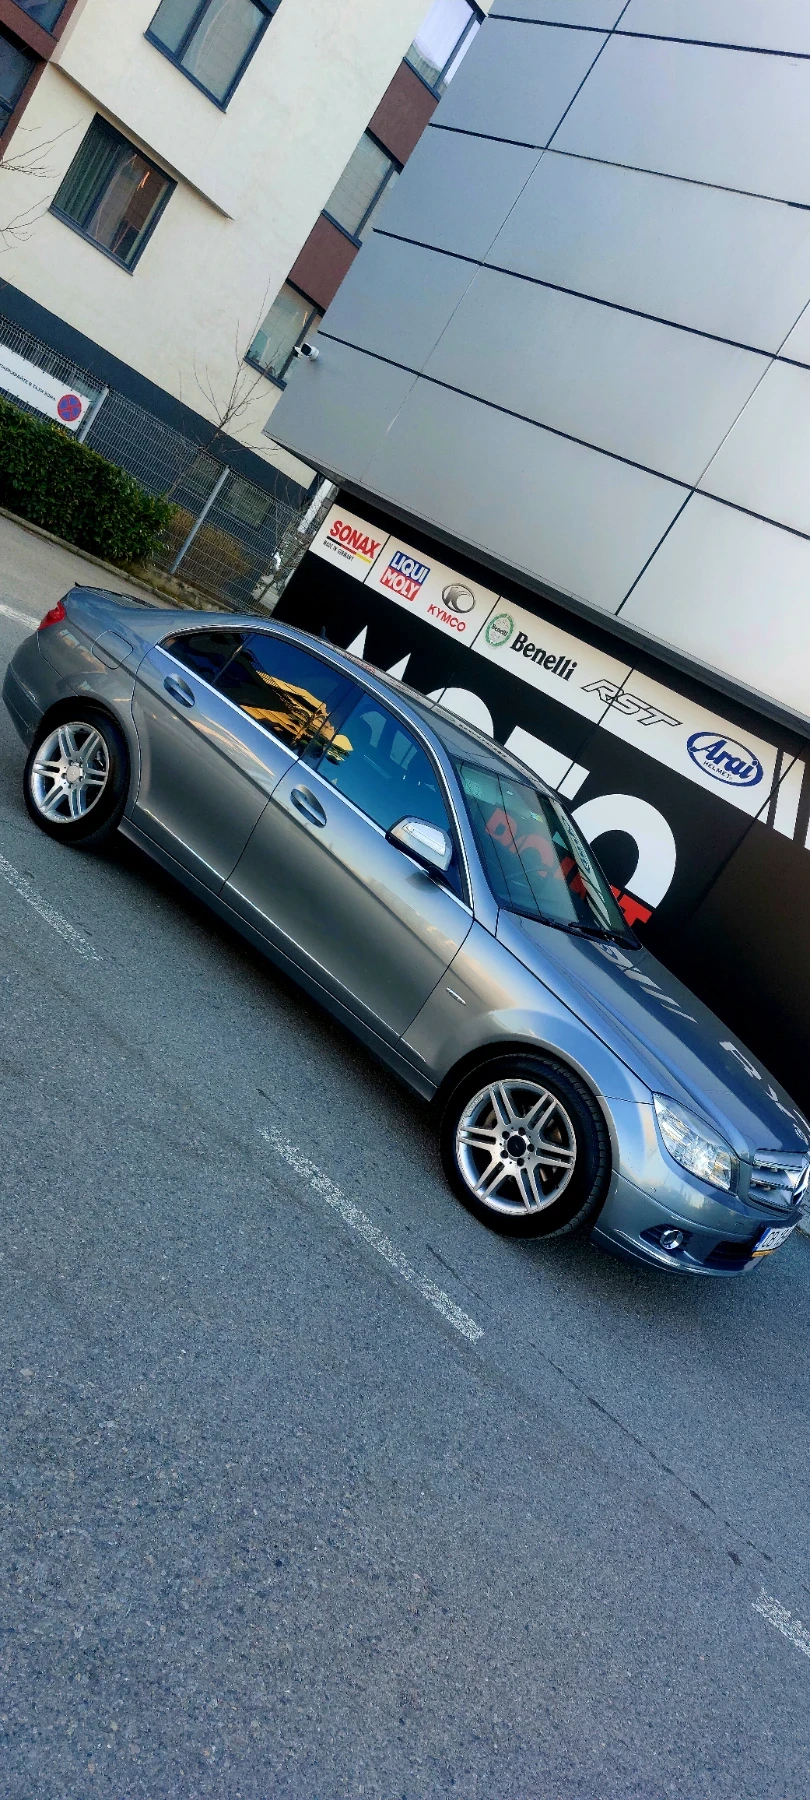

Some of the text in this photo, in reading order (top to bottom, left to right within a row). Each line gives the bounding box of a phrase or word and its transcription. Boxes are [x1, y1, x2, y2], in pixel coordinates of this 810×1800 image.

[329, 520, 381, 560] SONAX
[382, 568, 420, 601] MOLY
[392, 552, 430, 583] LIQUI
[427, 603, 466, 633] KYMCO
[510, 631, 578, 681] Benelli
[580, 679, 684, 727] RST
[688, 739, 759, 780] Arai
[703, 761, 732, 780] HELMET
